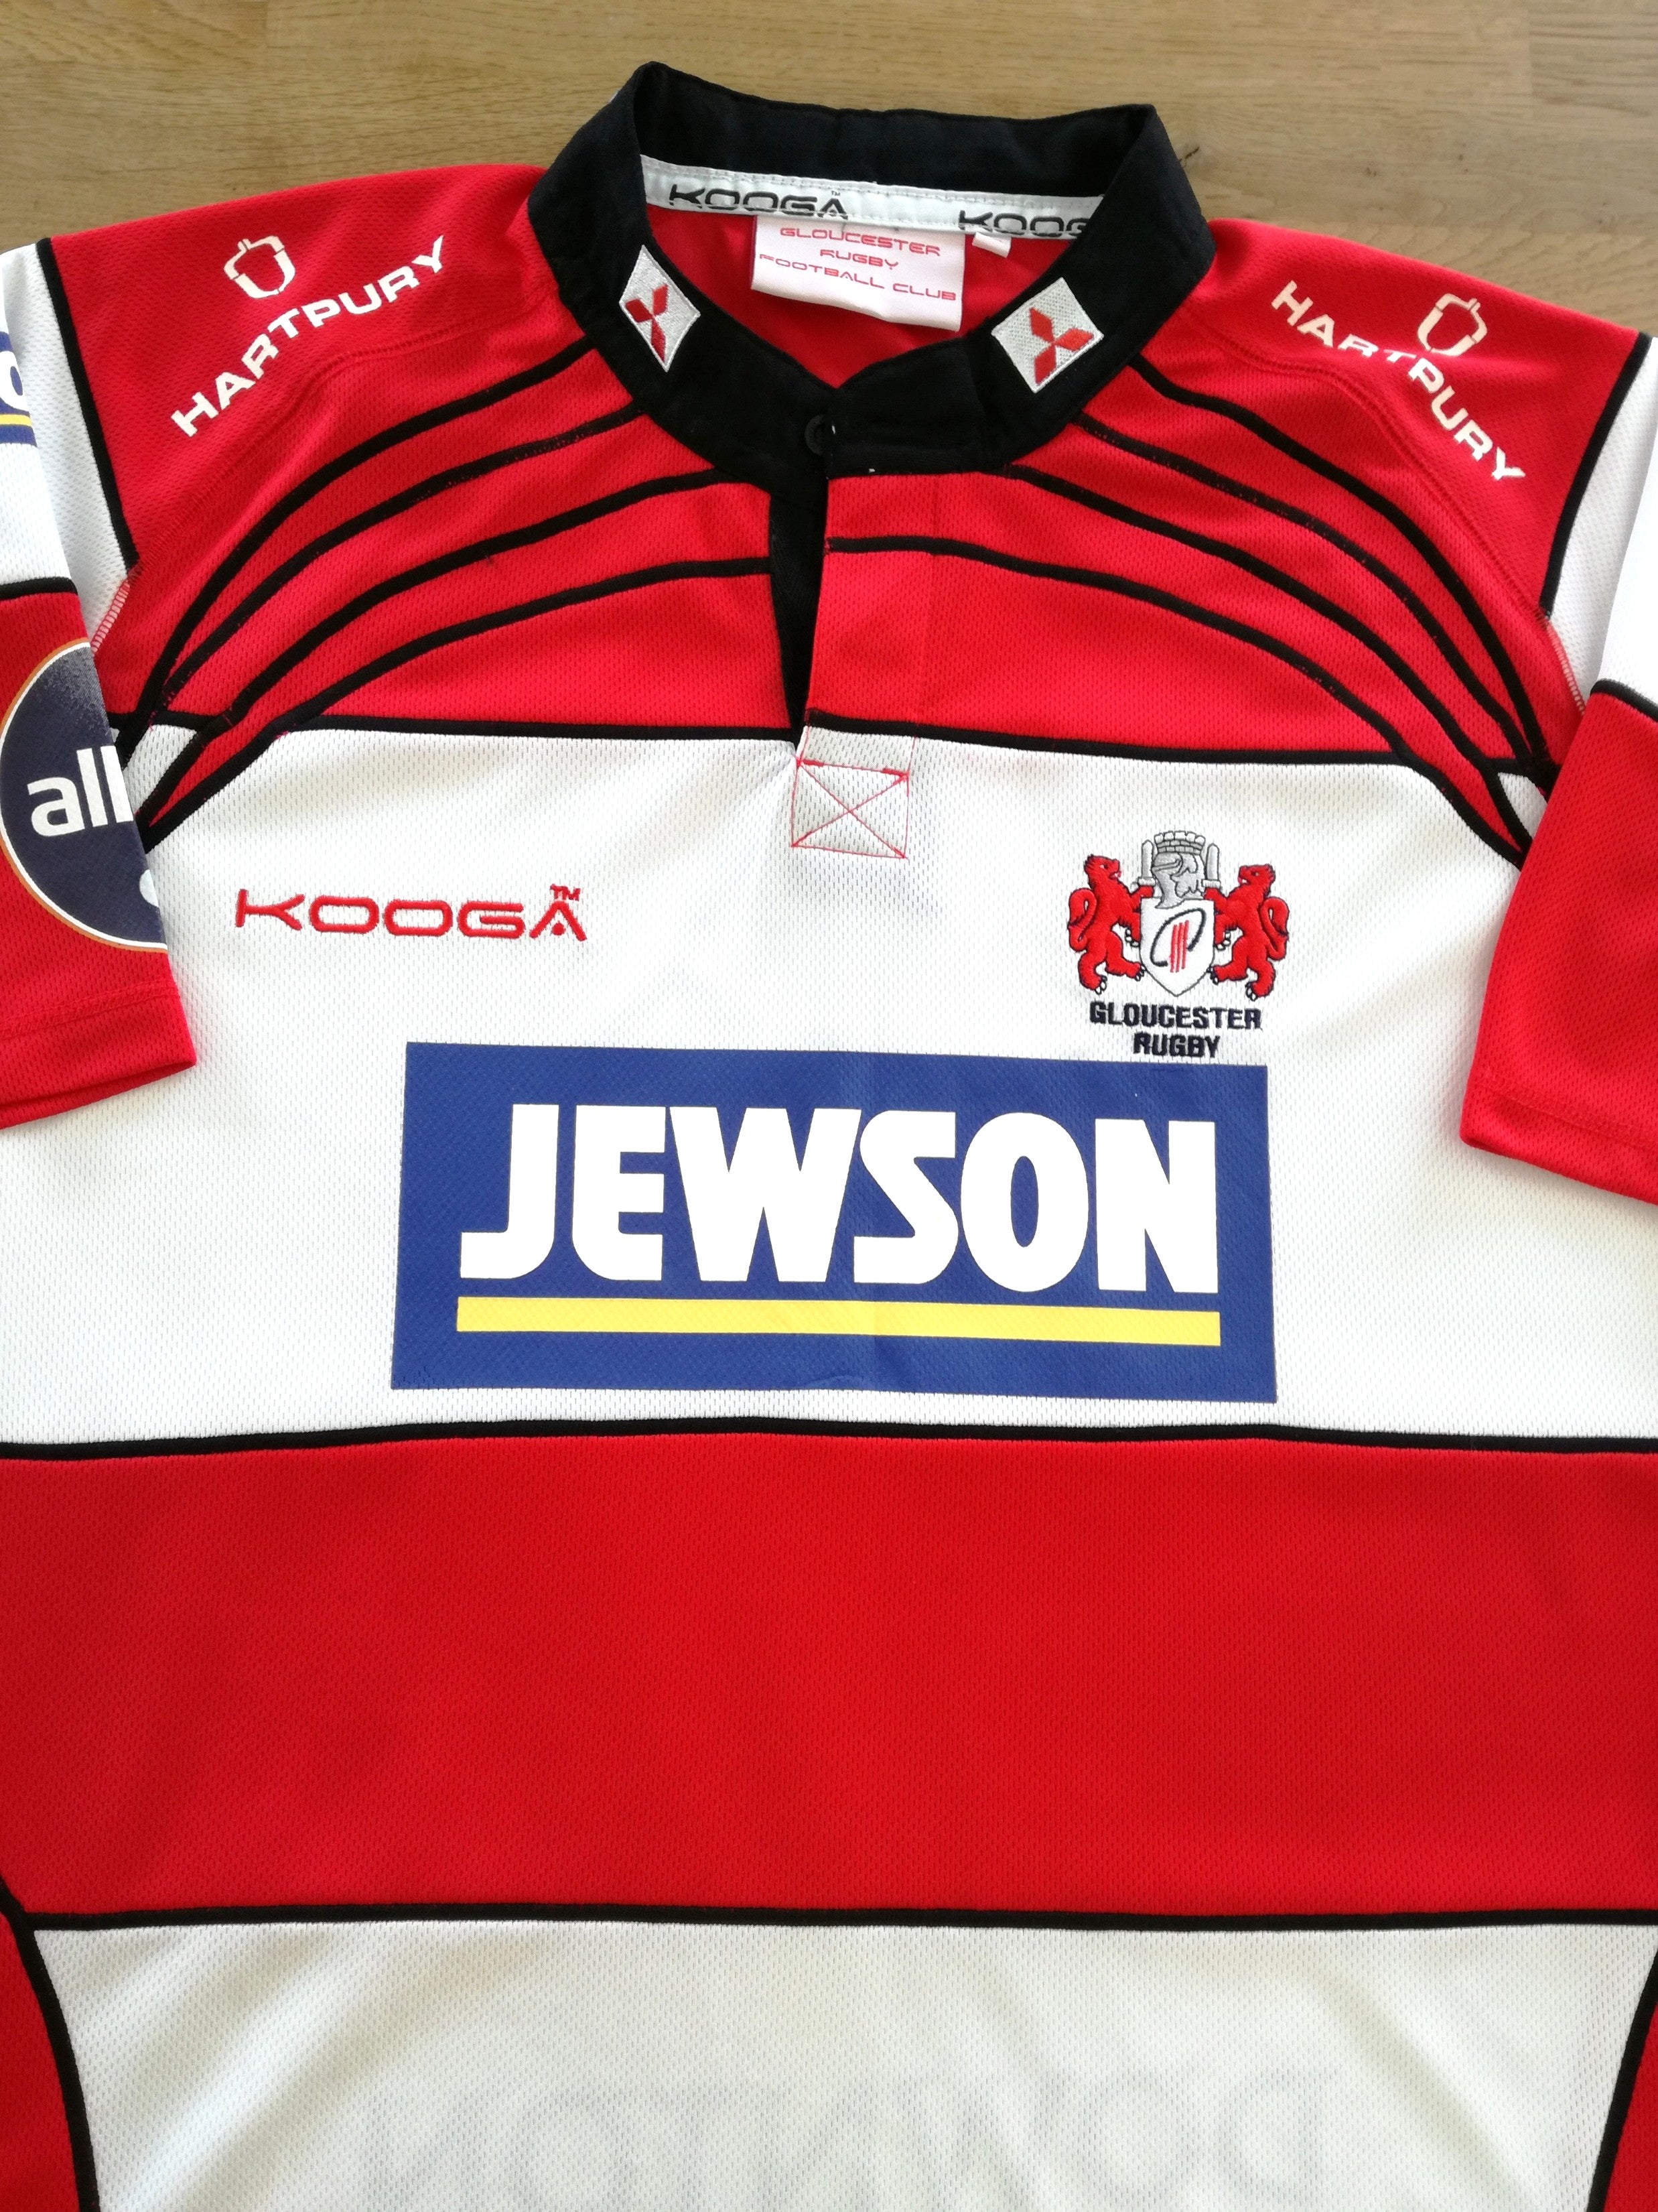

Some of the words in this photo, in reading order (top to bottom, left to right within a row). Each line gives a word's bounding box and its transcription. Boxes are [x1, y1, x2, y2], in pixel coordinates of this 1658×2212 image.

[669, 184, 849, 219] KOOGA
[780, 227, 941, 256] GLOUCESTER
[819, 249, 898, 269] RUGBY
[759, 254, 885, 288] FOOTBALL
[892, 283, 957, 301] CLUB
[171, 235, 444, 437] HARTPURY
[1271, 280, 1526, 480] HARTPURY
[235, 889, 588, 941] KOOGA
[1089, 1001, 1262, 1029] GLOUCESTER
[1133, 1031, 1220, 1057] RUGBY
[460, 1104, 1219, 1294] JEWSON
